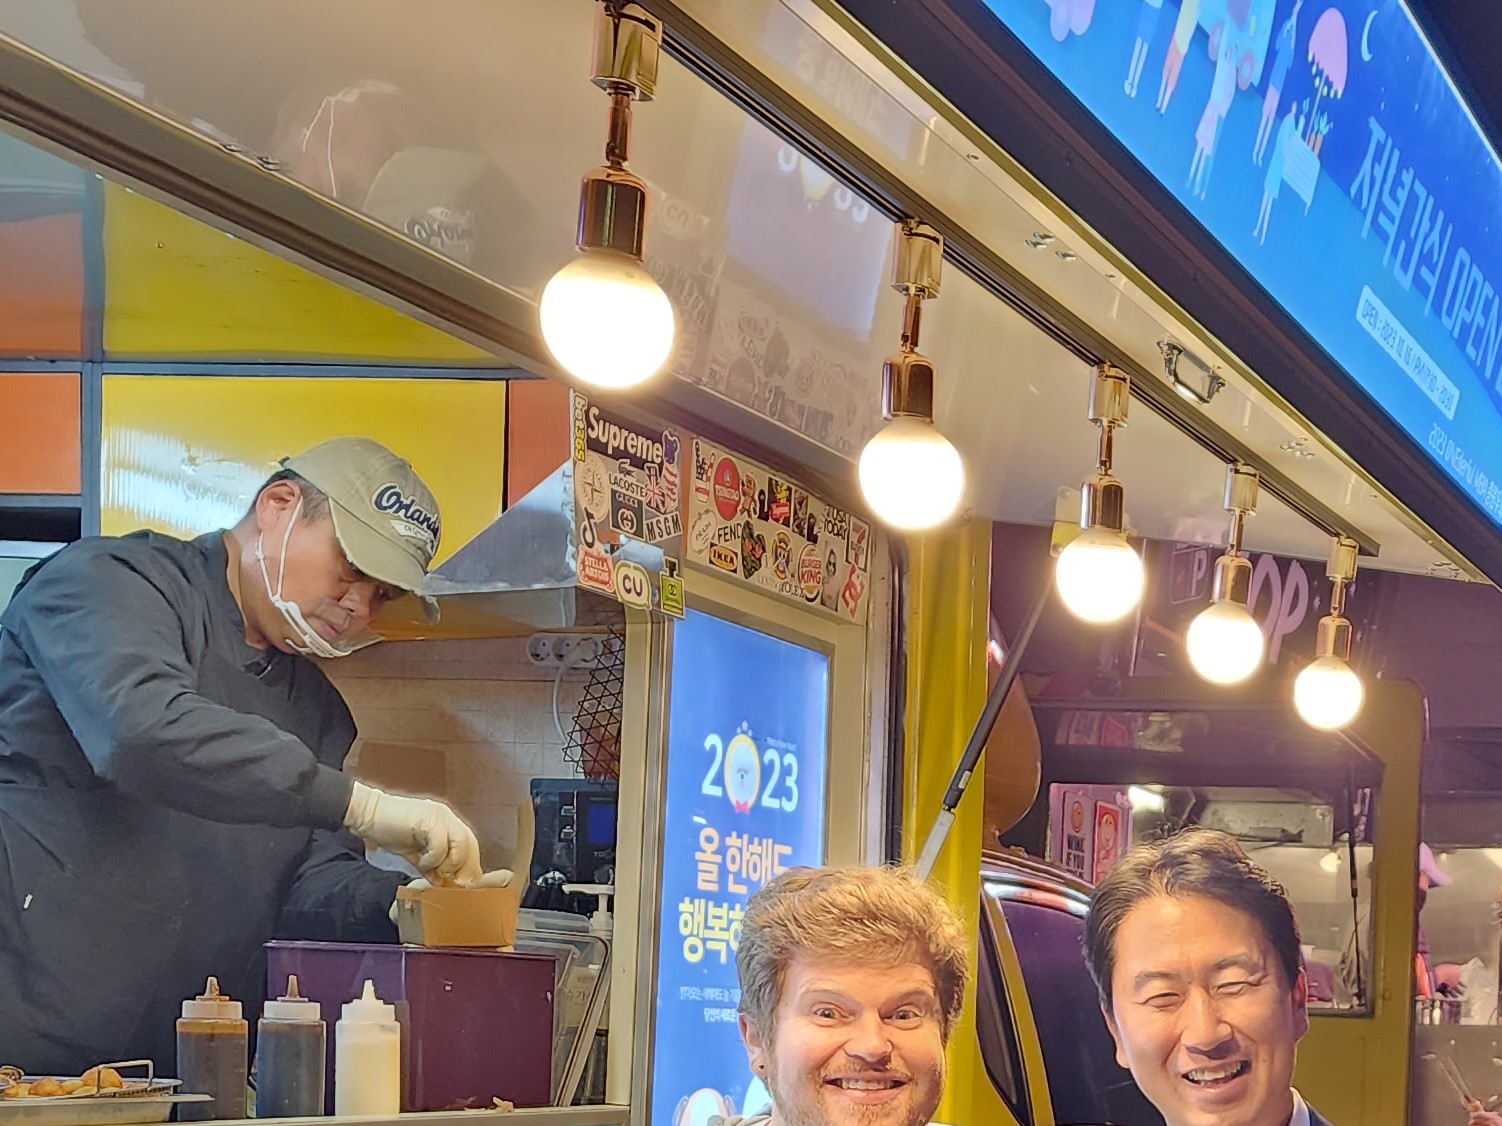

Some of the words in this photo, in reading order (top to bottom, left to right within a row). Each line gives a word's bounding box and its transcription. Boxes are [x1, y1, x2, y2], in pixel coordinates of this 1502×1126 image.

[587, 406, 663, 464] Supreme
[609, 472, 645, 498] LACOSTE
[646, 513, 680, 541] MSGM
[717, 523, 742, 544] FEND
[713, 549, 735, 566] IKEA
[622, 573, 643, 598] CU
[800, 569, 821, 585] KING
[701, 732, 799, 813] 2023
[695, 827, 722, 892] 올
